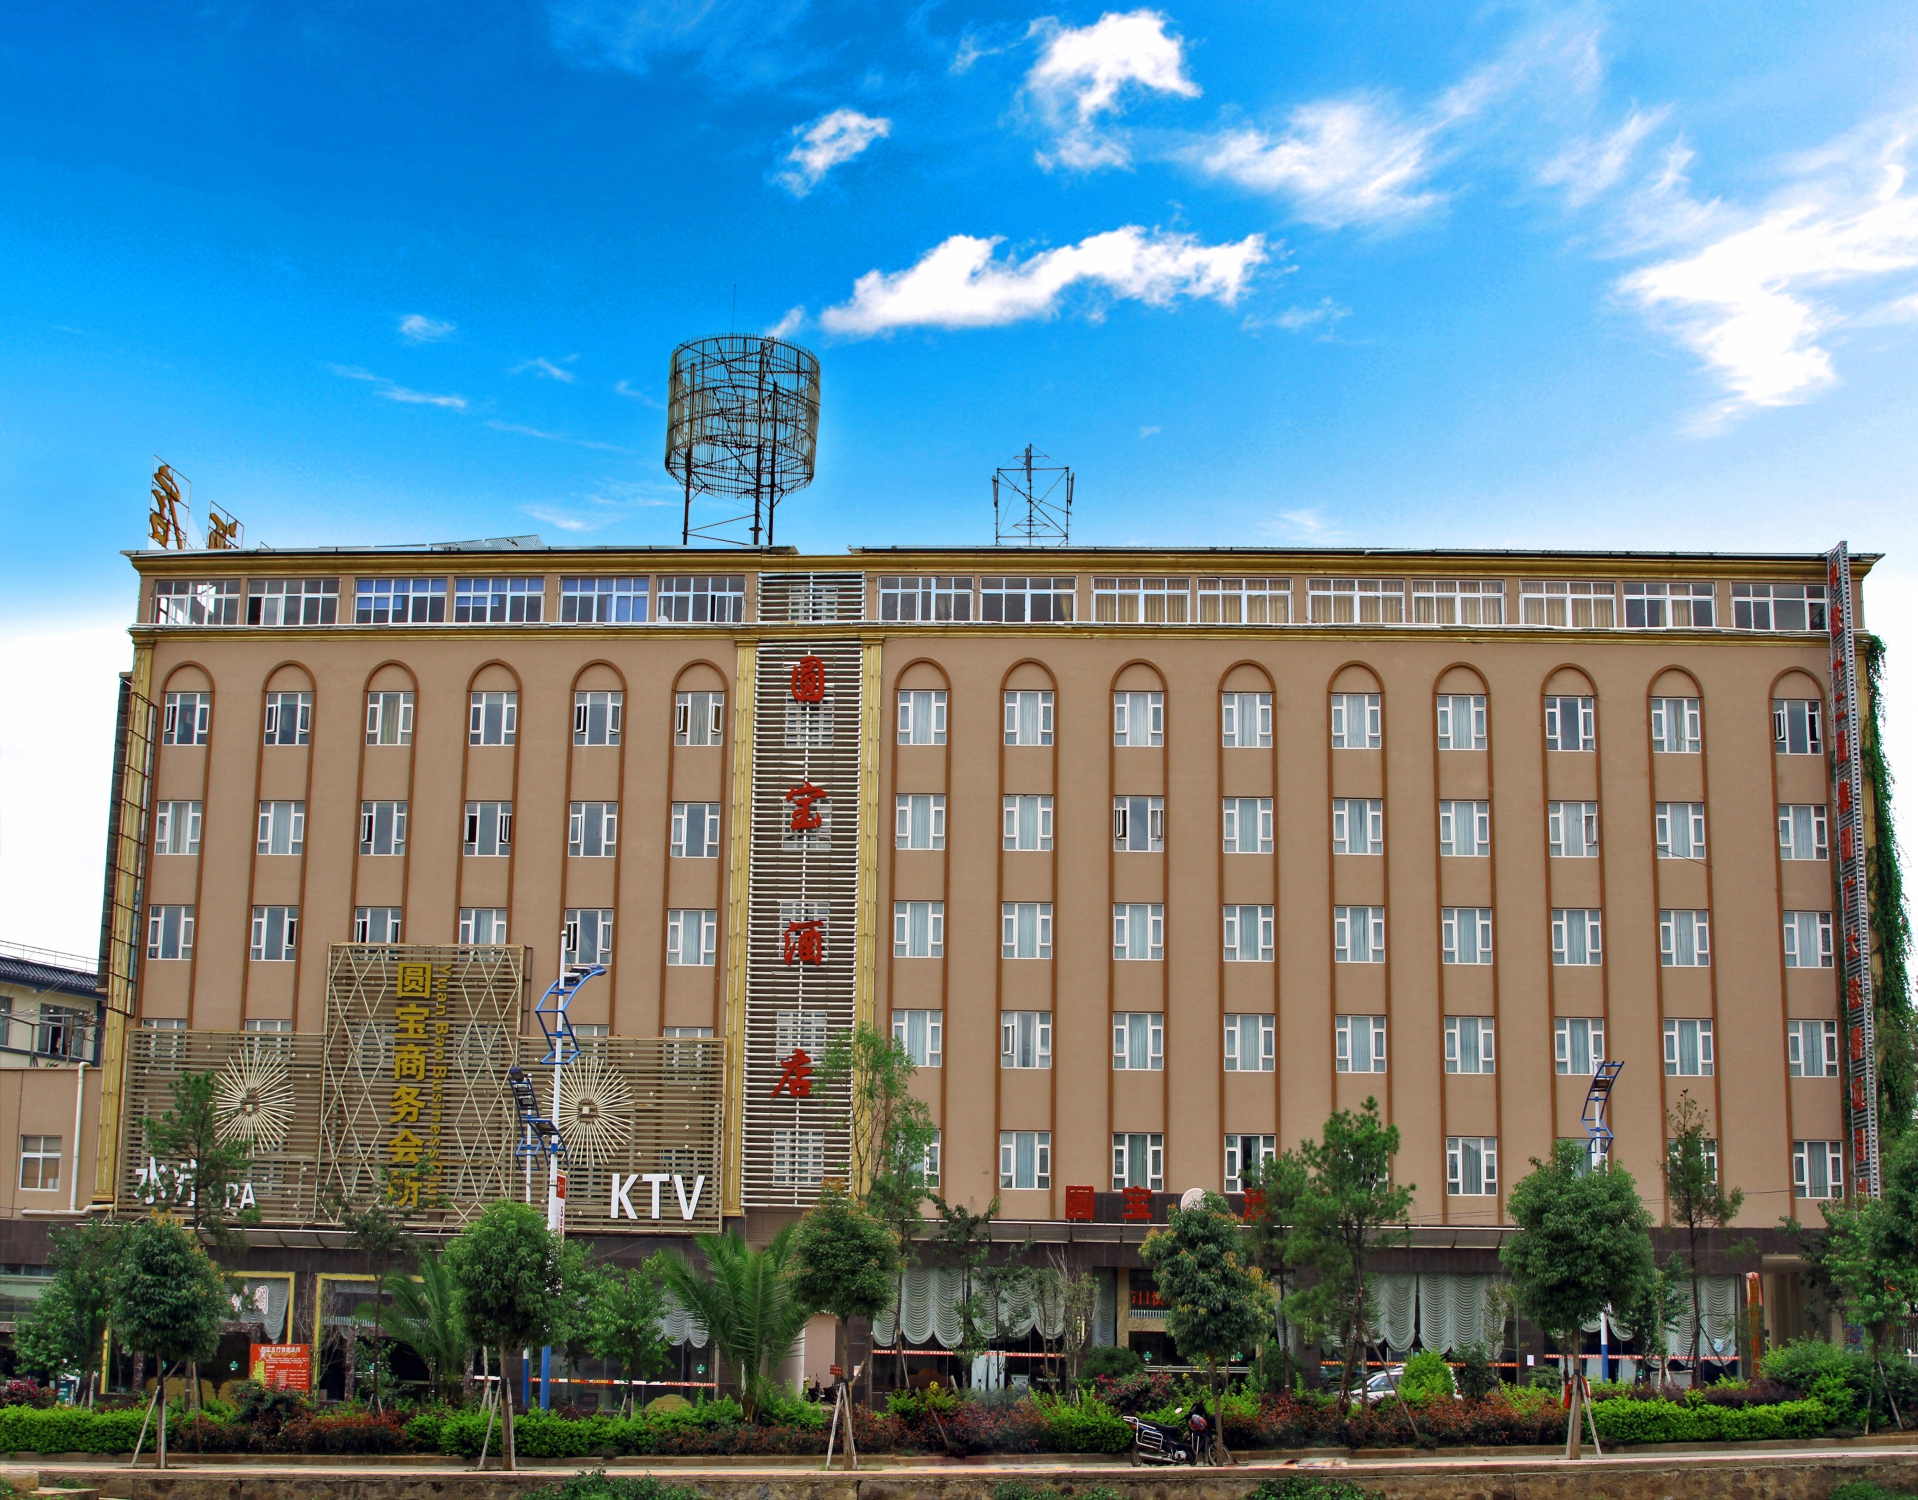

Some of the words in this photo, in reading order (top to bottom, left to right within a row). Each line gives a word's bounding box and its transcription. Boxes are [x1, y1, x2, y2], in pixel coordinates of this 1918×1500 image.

[436, 963, 452, 1016] Yuan
[434, 1022, 449, 1060] Bao
[388, 963, 432, 1207] 圆宝商务会所
[431, 1066, 448, 1159] Business
[610, 1173, 705, 1220] KTV
